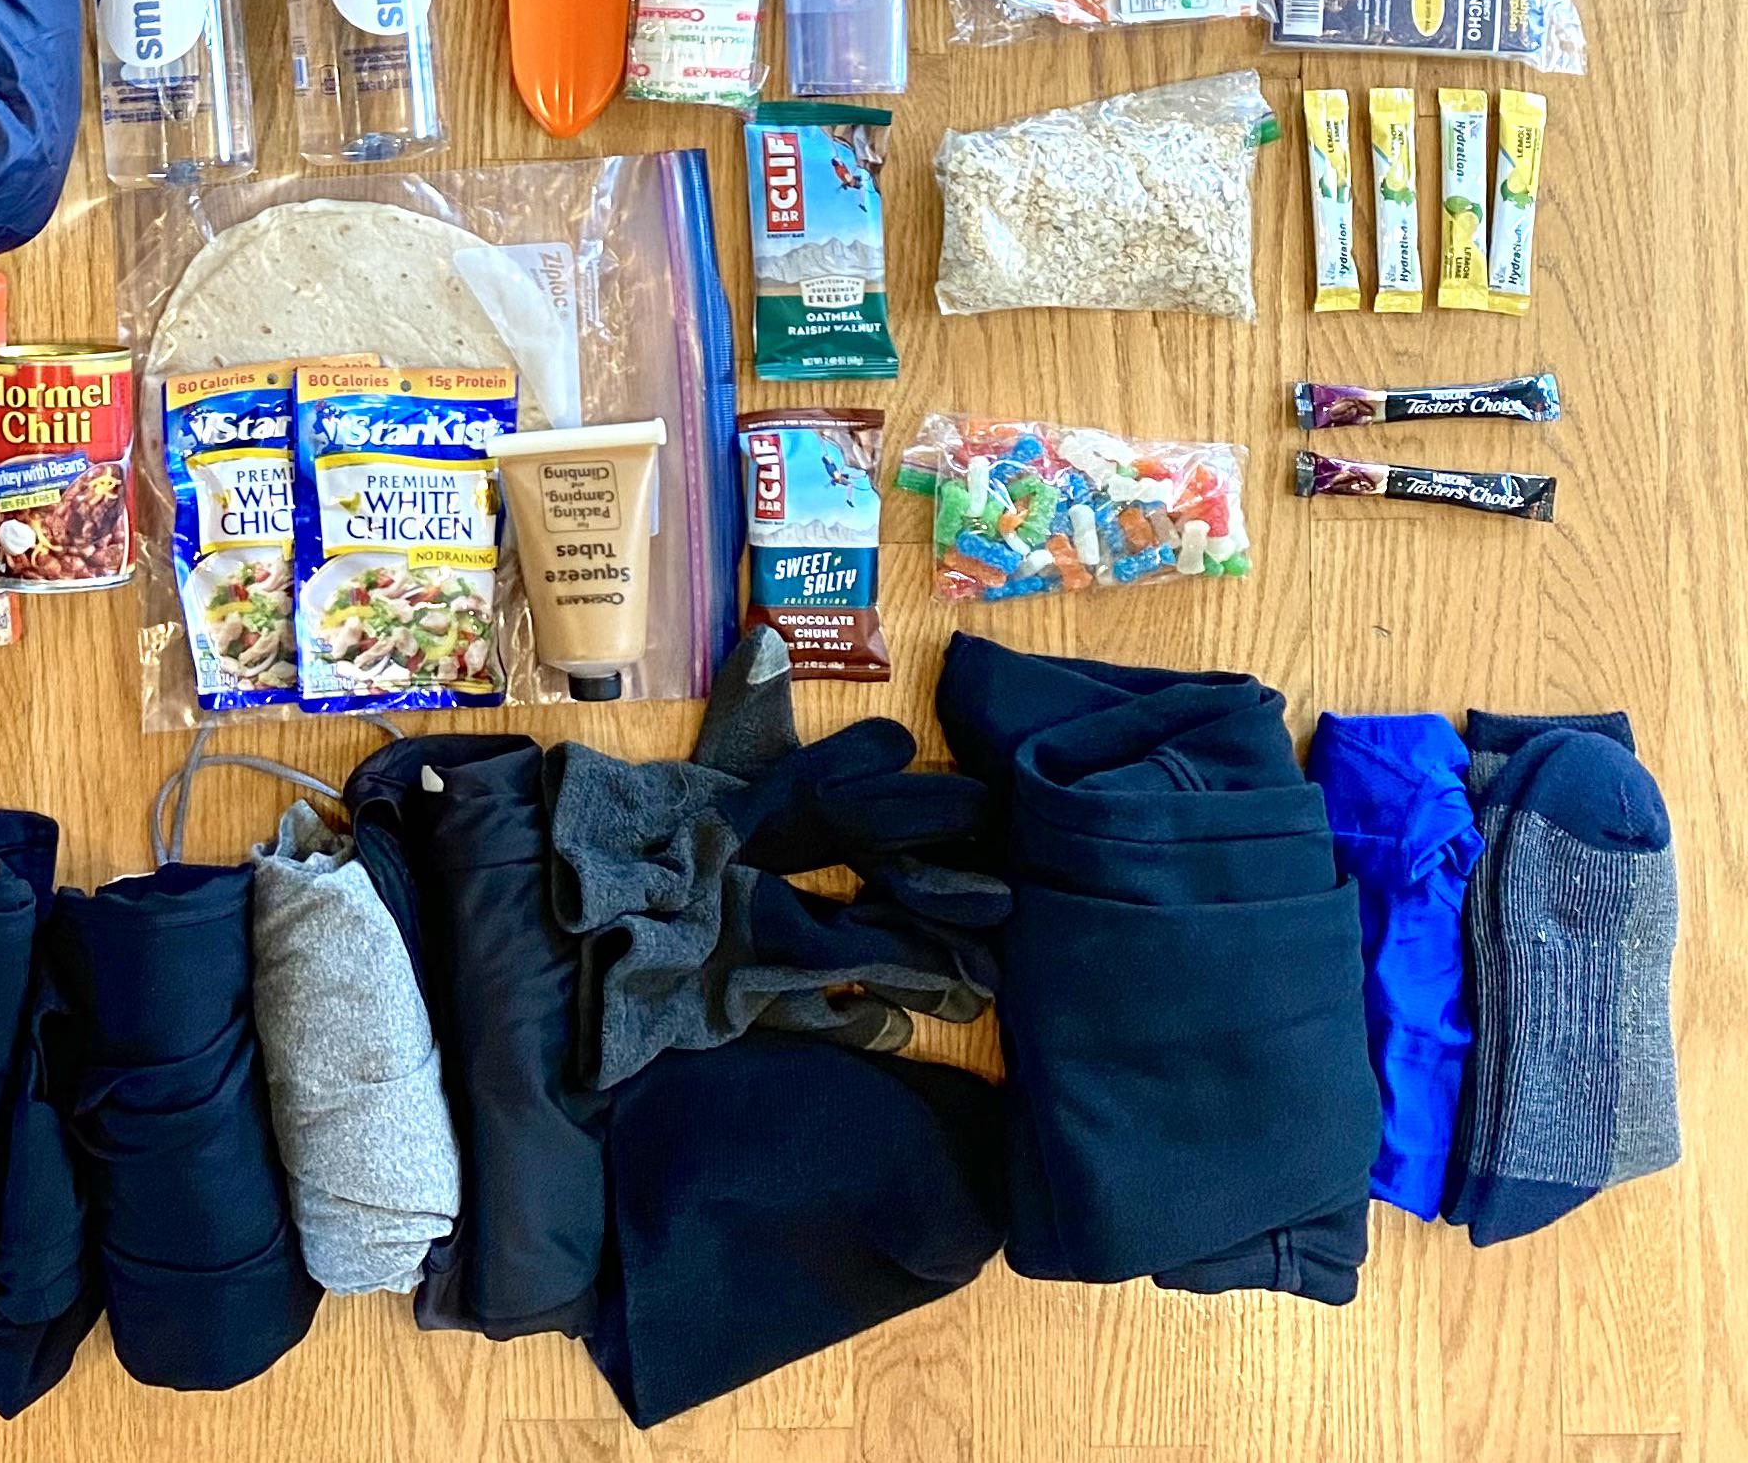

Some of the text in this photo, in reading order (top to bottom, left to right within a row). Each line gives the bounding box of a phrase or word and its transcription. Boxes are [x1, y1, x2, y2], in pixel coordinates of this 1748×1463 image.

[768, 137, 799, 210] CLIF
[771, 210, 800, 223] BAR
[538, 250, 568, 308] Ziploc
[808, 294, 859, 304] ENERGY
[806, 311, 863, 322] OATMEAL
[788, 322, 882, 336] RAISIN WALNUT
[177, 373, 256, 395] 80 Calories
[308, 374, 389, 387] 80 Calories
[427, 375, 507, 390] 15g Protein
[2, 410, 92, 444] Chili
[22, 463, 50, 484] with
[49, 457, 87, 476] Beans
[544, 467, 610, 480] Climbing
[753, 439, 781, 500] CLIF
[367, 475, 456, 489] PREMIUM
[15, 497, 32, 508] FAT
[33, 493, 59, 506] FREE
[365, 491, 460, 515] WHITE
[545, 490, 615, 505] Camping,
[1469, 487, 1525, 509] Choice
[549, 506, 611, 521] Packing,
[757, 500, 782, 512] BAR
[347, 516, 472, 540] CHICKEN
[416, 552, 494, 564] NO DRAINING
[556, 542, 617, 559] Tubes
[545, 564, 631, 583] Squeeze
[774, 552, 832, 580] SWEET
[803, 568, 858, 597] SALTY
[778, 615, 855, 626] CHOCOLATE
[794, 628, 840, 639] CHUNK
[797, 641, 854, 651] SEA SALT
